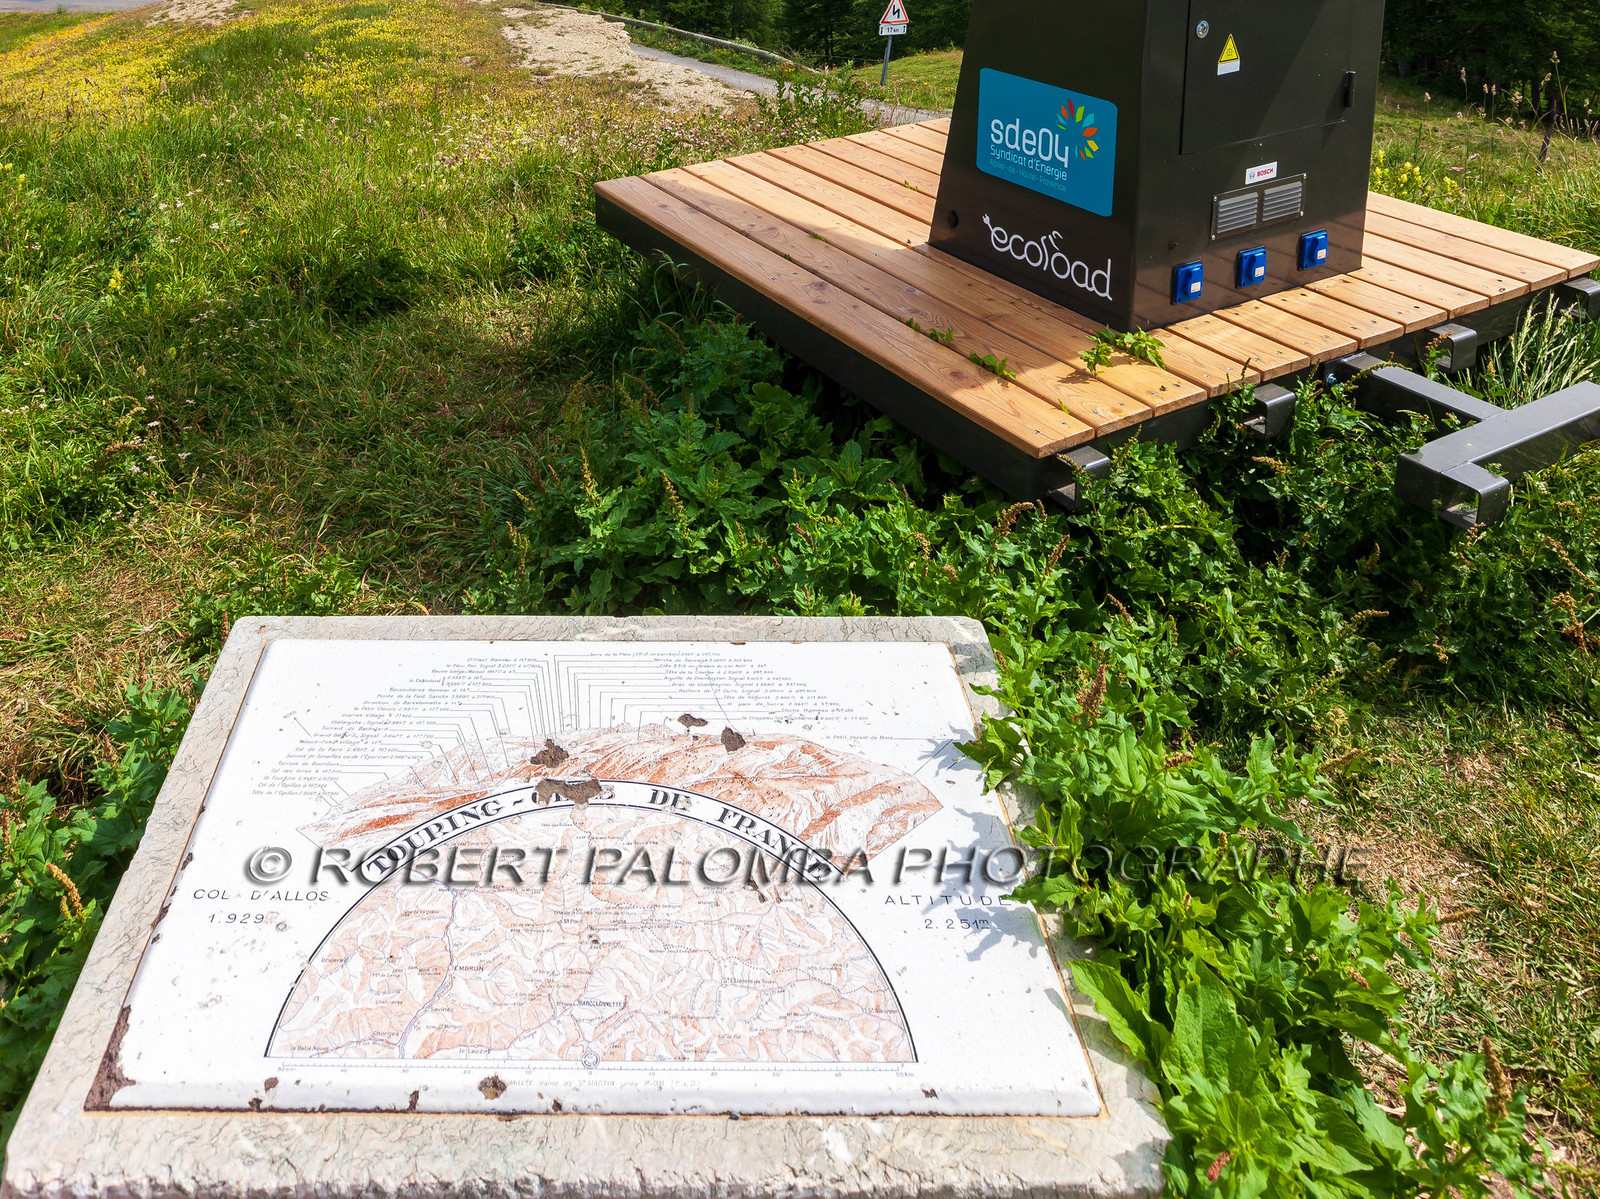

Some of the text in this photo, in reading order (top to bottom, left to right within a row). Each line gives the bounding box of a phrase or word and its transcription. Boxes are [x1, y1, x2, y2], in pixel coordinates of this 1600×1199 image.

[990, 118, 1069, 169] sde04
[990, 144, 1027, 167] Syndicat
[1256, 167, 1274, 178] BOSCH
[366, 790, 836, 882] TOURING DE FRANCE
[193, 888, 329, 901] COL D'ALLOS
[884, 895, 1012, 906] ALTITUDE
[208, 912, 265, 924] 1.929
